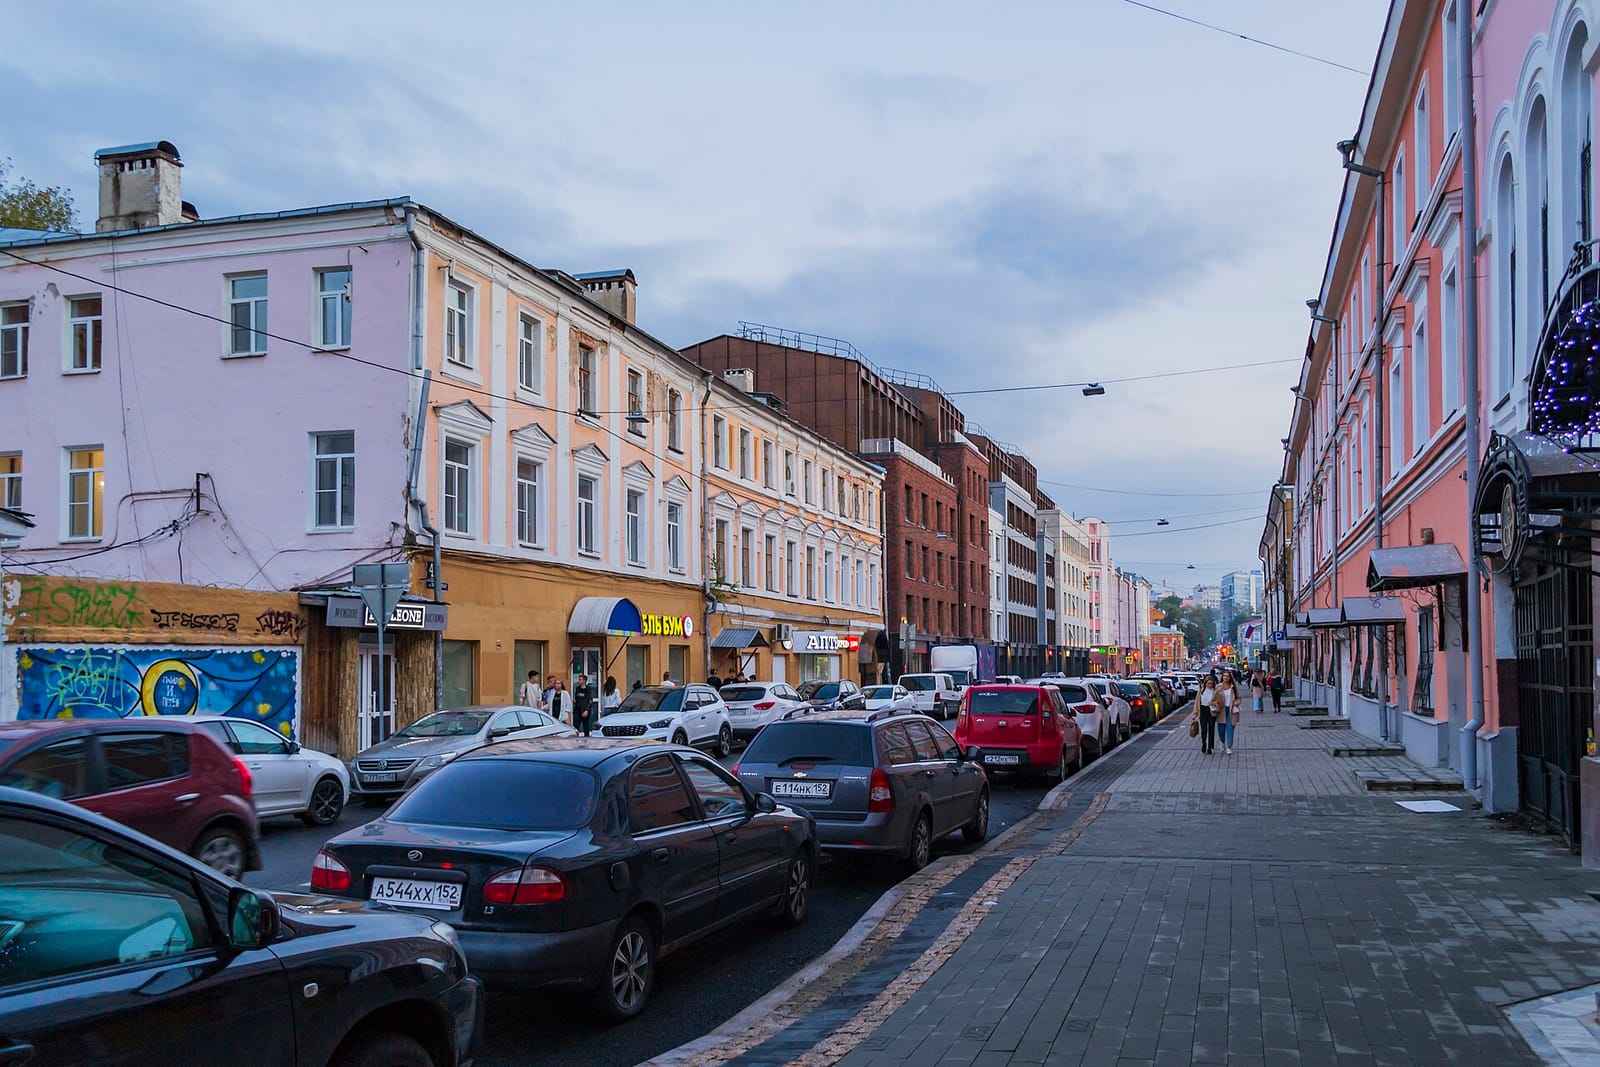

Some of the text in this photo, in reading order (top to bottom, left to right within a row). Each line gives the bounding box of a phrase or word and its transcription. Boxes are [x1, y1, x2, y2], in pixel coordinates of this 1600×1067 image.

[428, 563, 435, 578] 4
[663, 615, 684, 636] БУМ
[775, 783, 827, 794] Е114НК 152
[376, 881, 458, 902] А544ХХ 152
